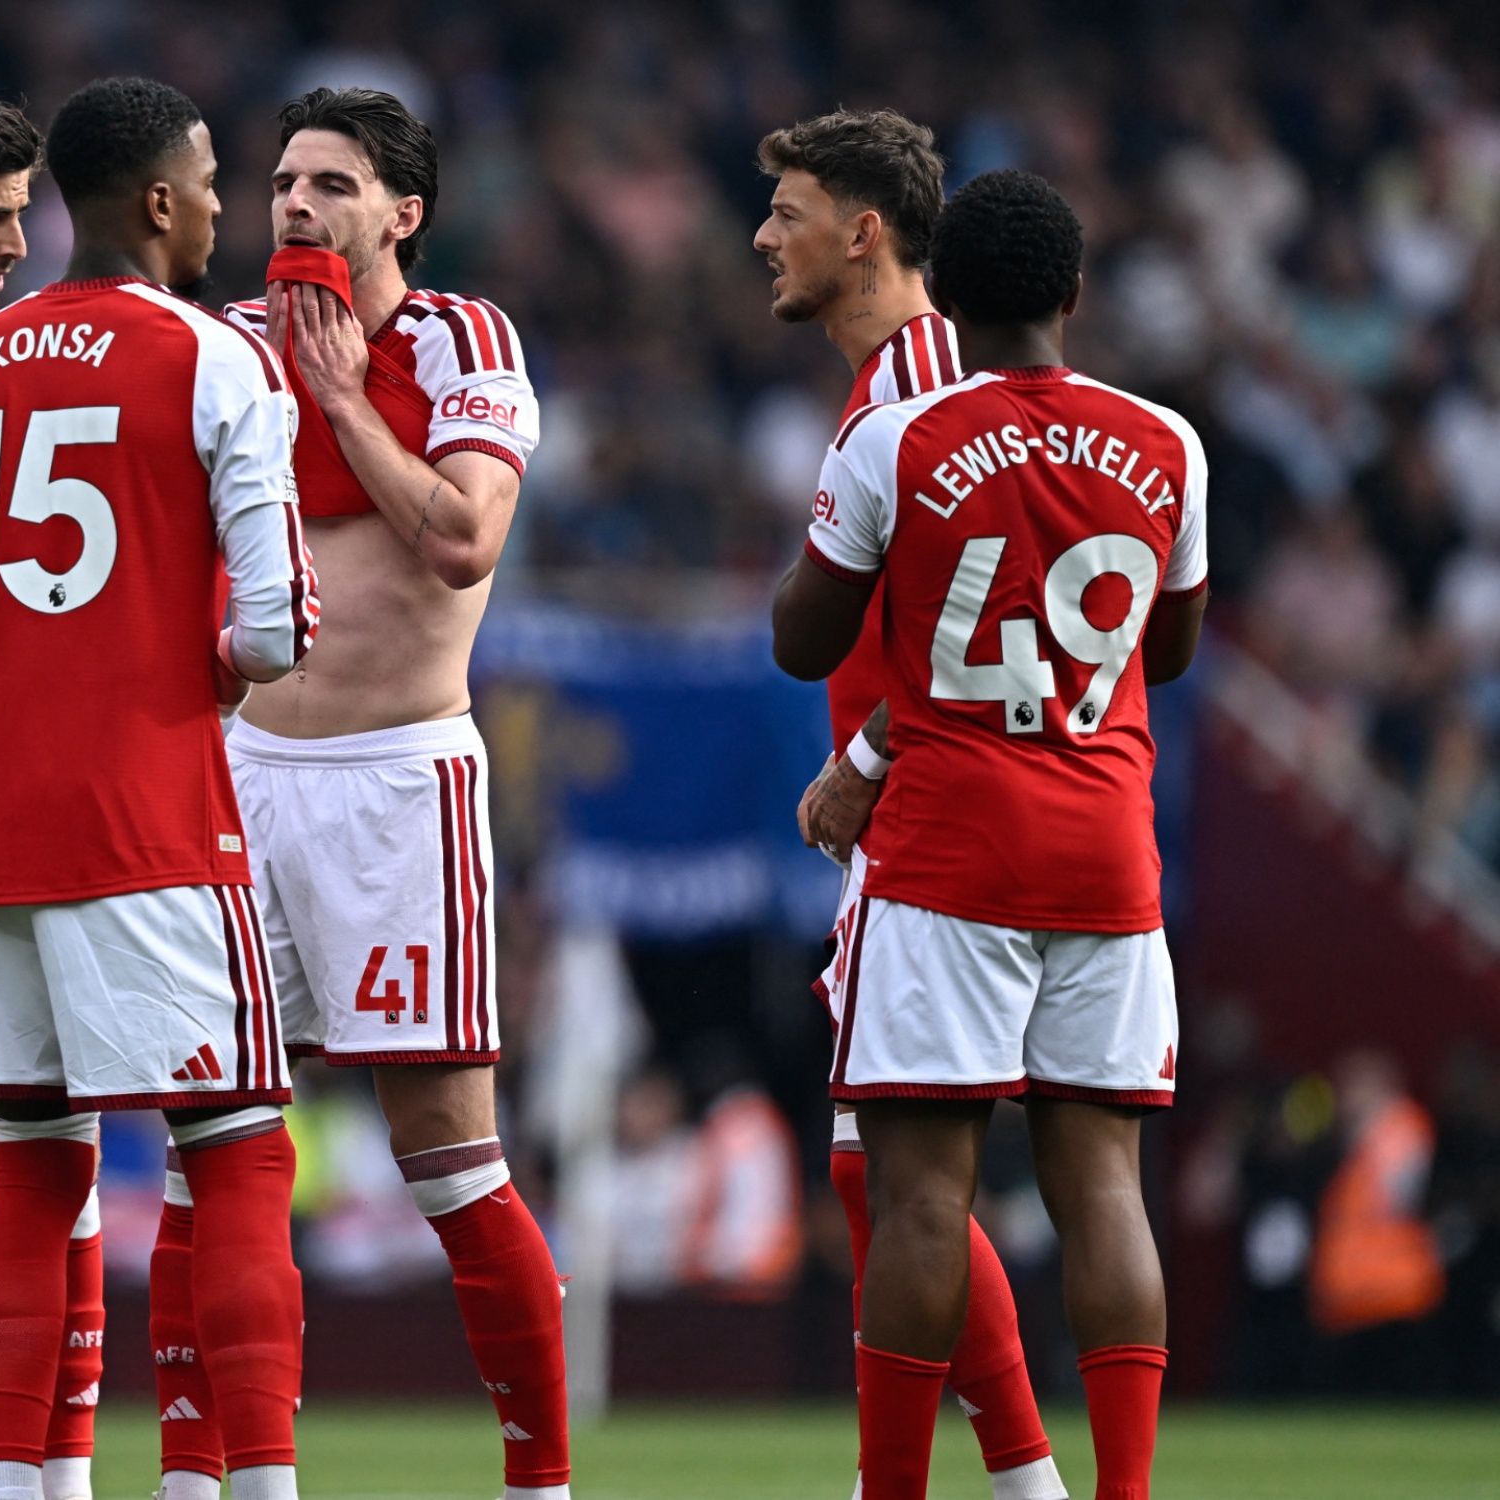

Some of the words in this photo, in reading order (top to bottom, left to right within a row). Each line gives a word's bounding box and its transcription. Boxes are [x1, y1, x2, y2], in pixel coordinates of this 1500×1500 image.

[915, 424, 1174, 519] LEWIS-SKELLY
[930, 534, 1159, 734] 49
[356, 945, 428, 1024] 41
[155, 1346, 195, 1365] AFC
